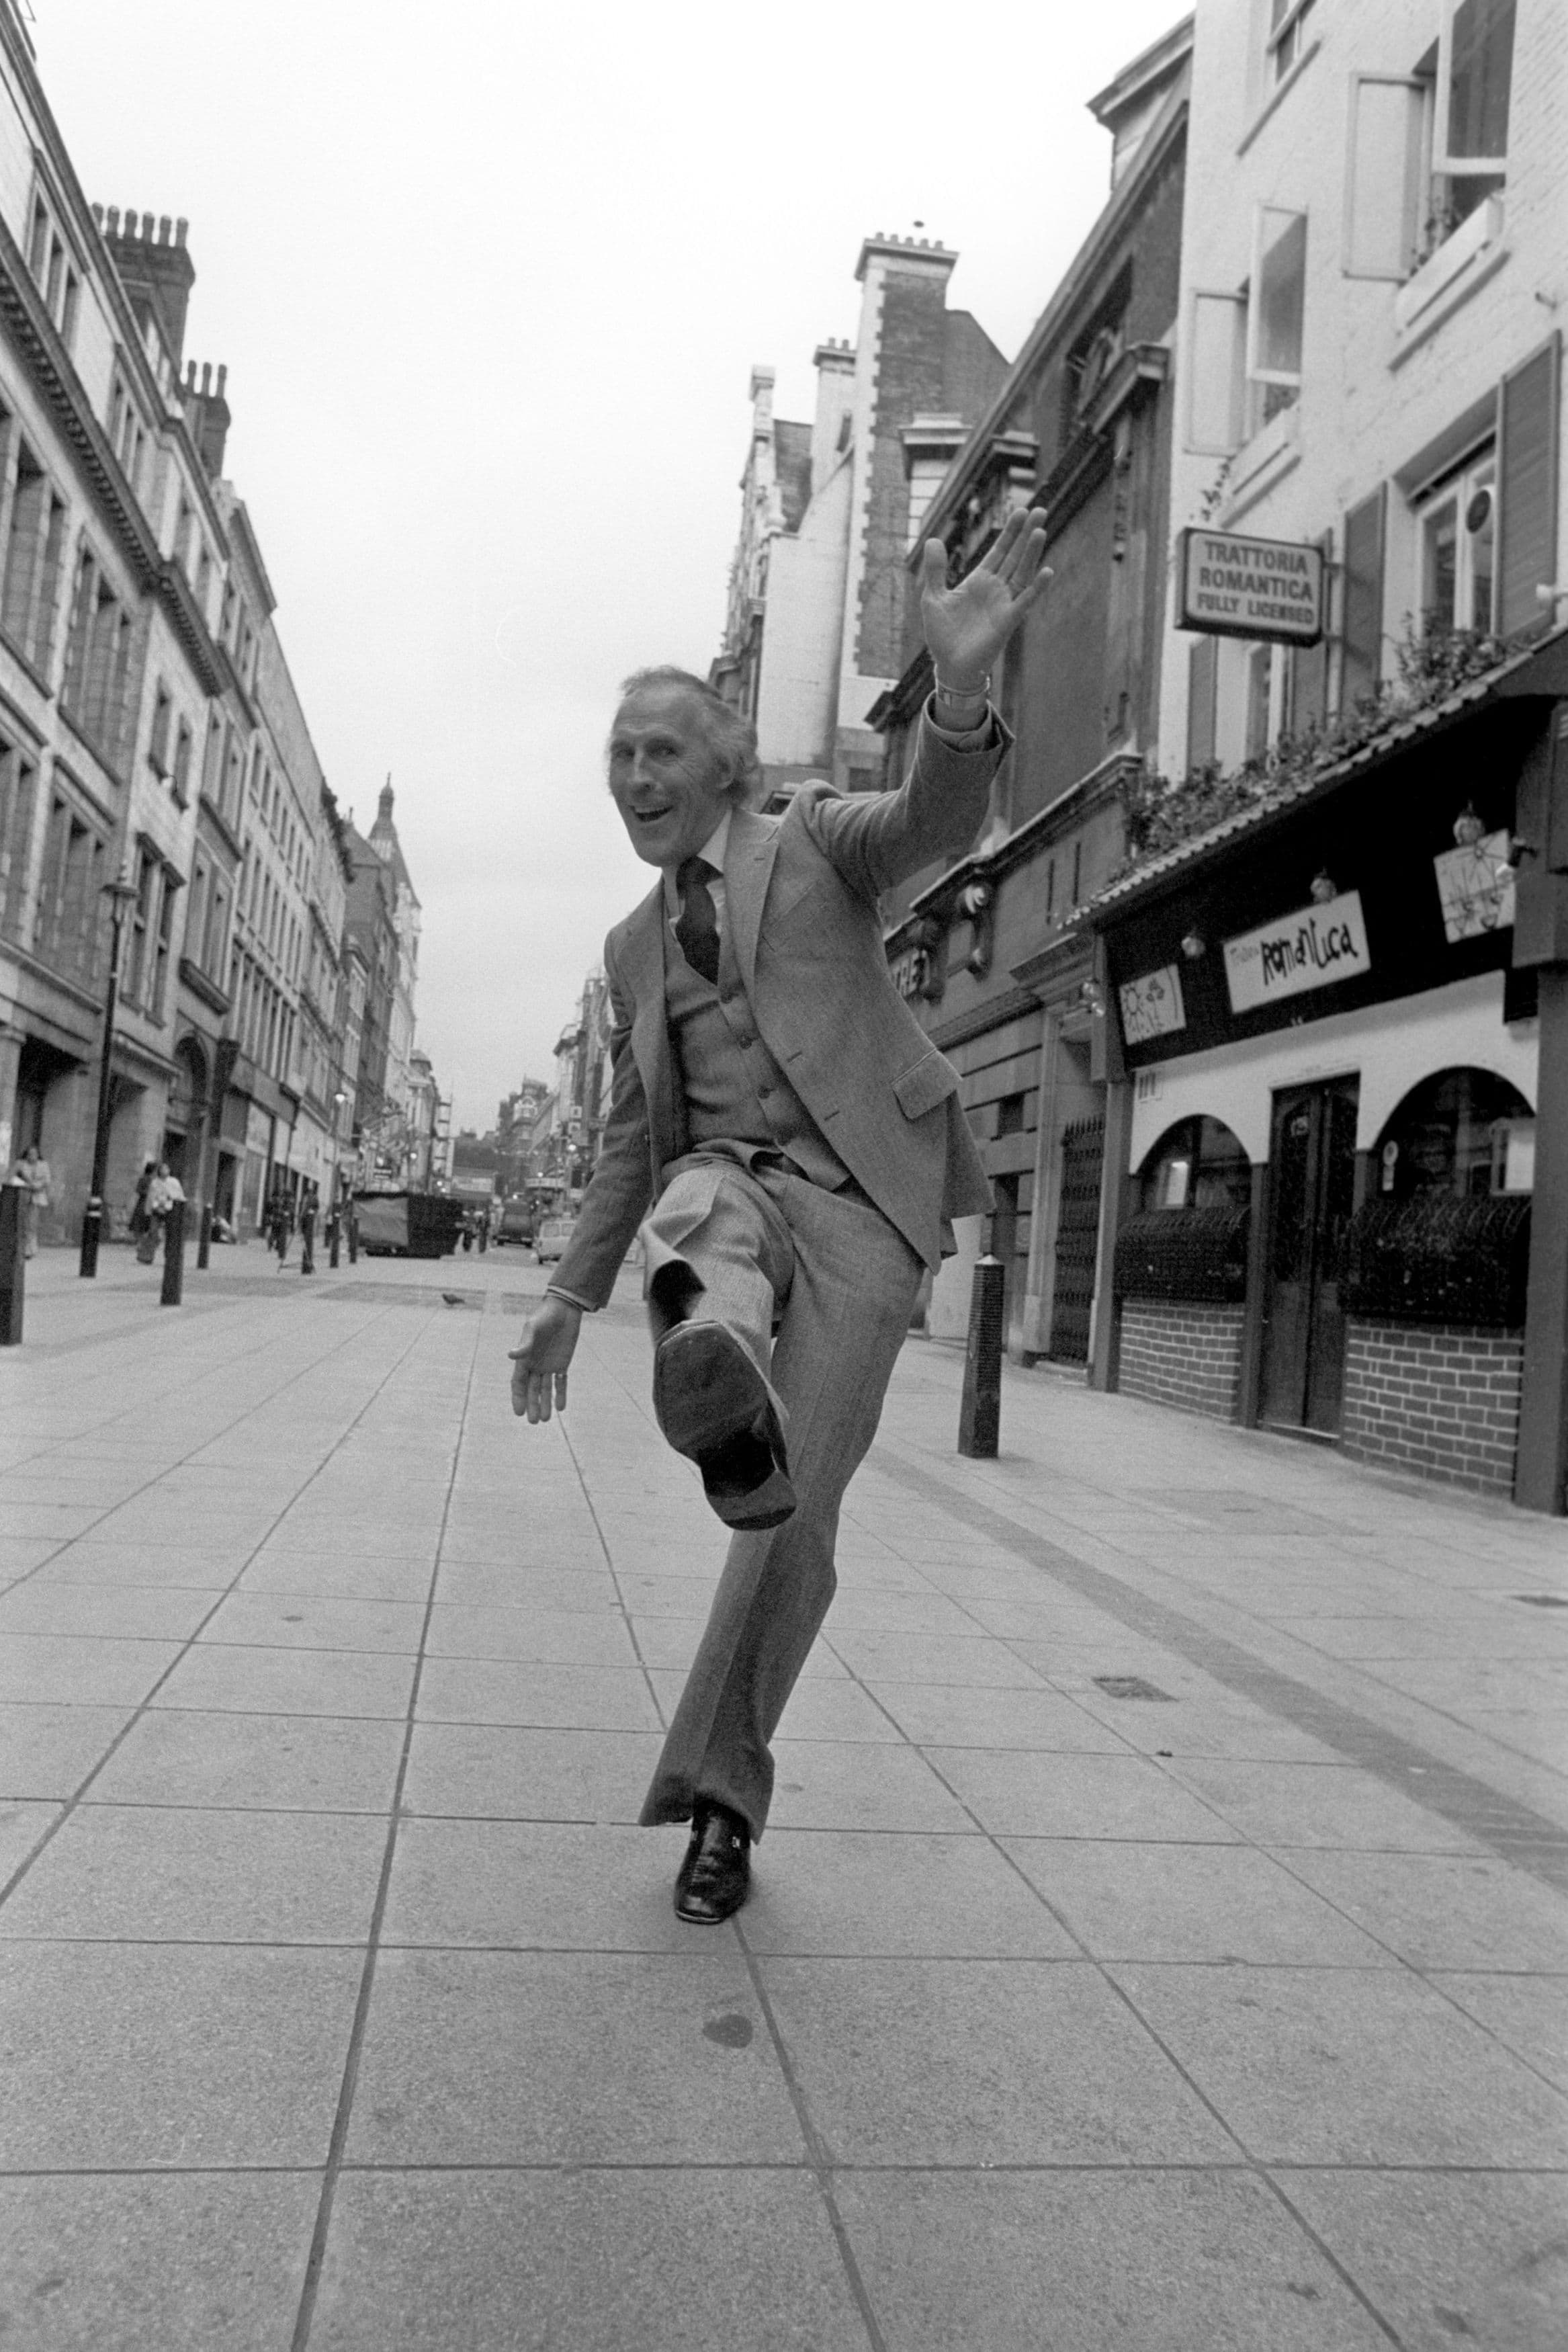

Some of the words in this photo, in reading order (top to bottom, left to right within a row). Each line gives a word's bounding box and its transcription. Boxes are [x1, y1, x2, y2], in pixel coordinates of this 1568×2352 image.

[1205, 540, 1308, 575] TRATTORIA
[1199, 566, 1313, 602] ROMANTICA
[1196, 592, 1240, 614] FULLY
[1247, 599, 1315, 625] LICENSED
